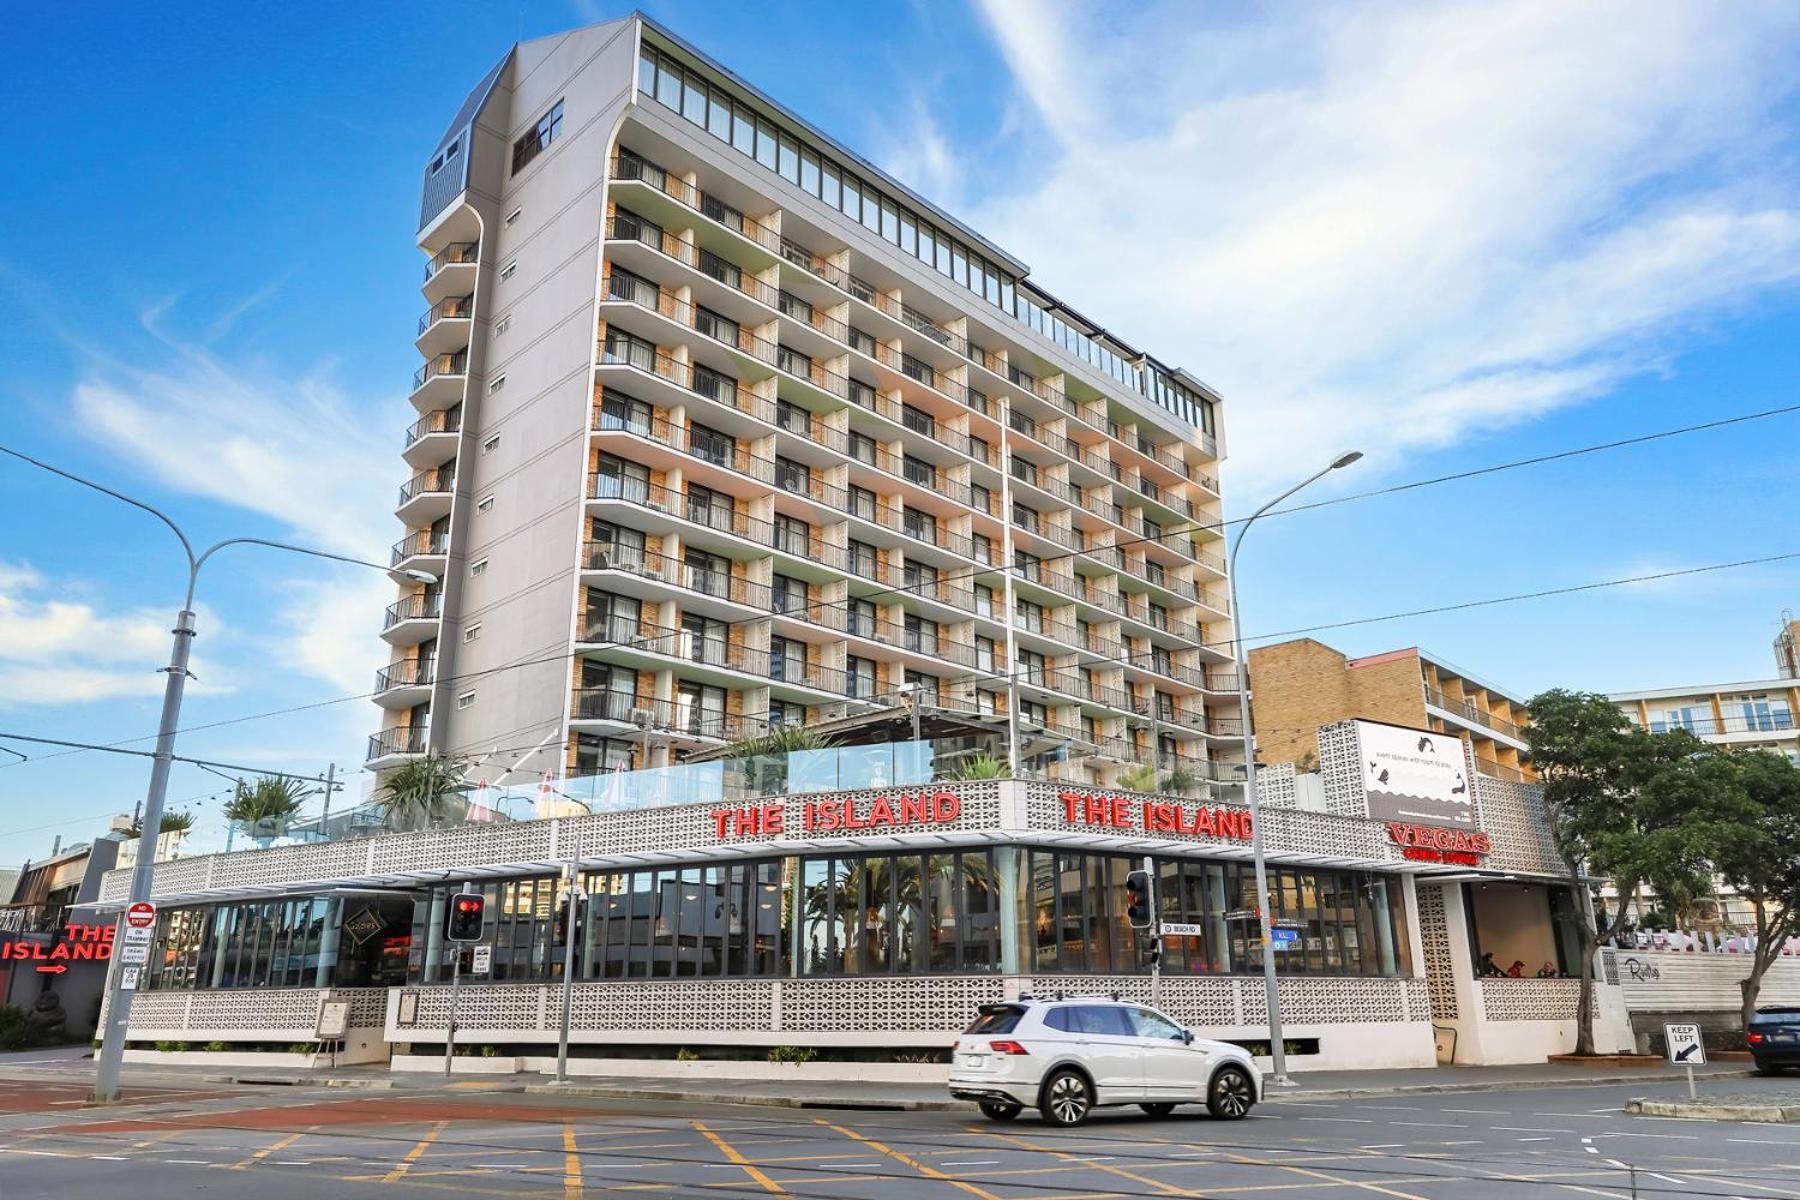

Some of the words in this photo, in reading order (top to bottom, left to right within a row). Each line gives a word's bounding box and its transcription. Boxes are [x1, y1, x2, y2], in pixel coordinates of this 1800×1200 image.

[709, 803, 784, 838] THE
[804, 791, 961, 831] ISLAND
[1059, 792, 1133, 828] THE
[1143, 801, 1254, 840] ISLAND
[1389, 821, 1492, 854] VEGAS
[131, 918, 150, 926] ENTRY
[64, 924, 117, 942] THE
[1, 941, 113, 960] ISLAND
[1671, 1026, 1694, 1034] KEEP
[1674, 1035, 1694, 1043] LEFT
